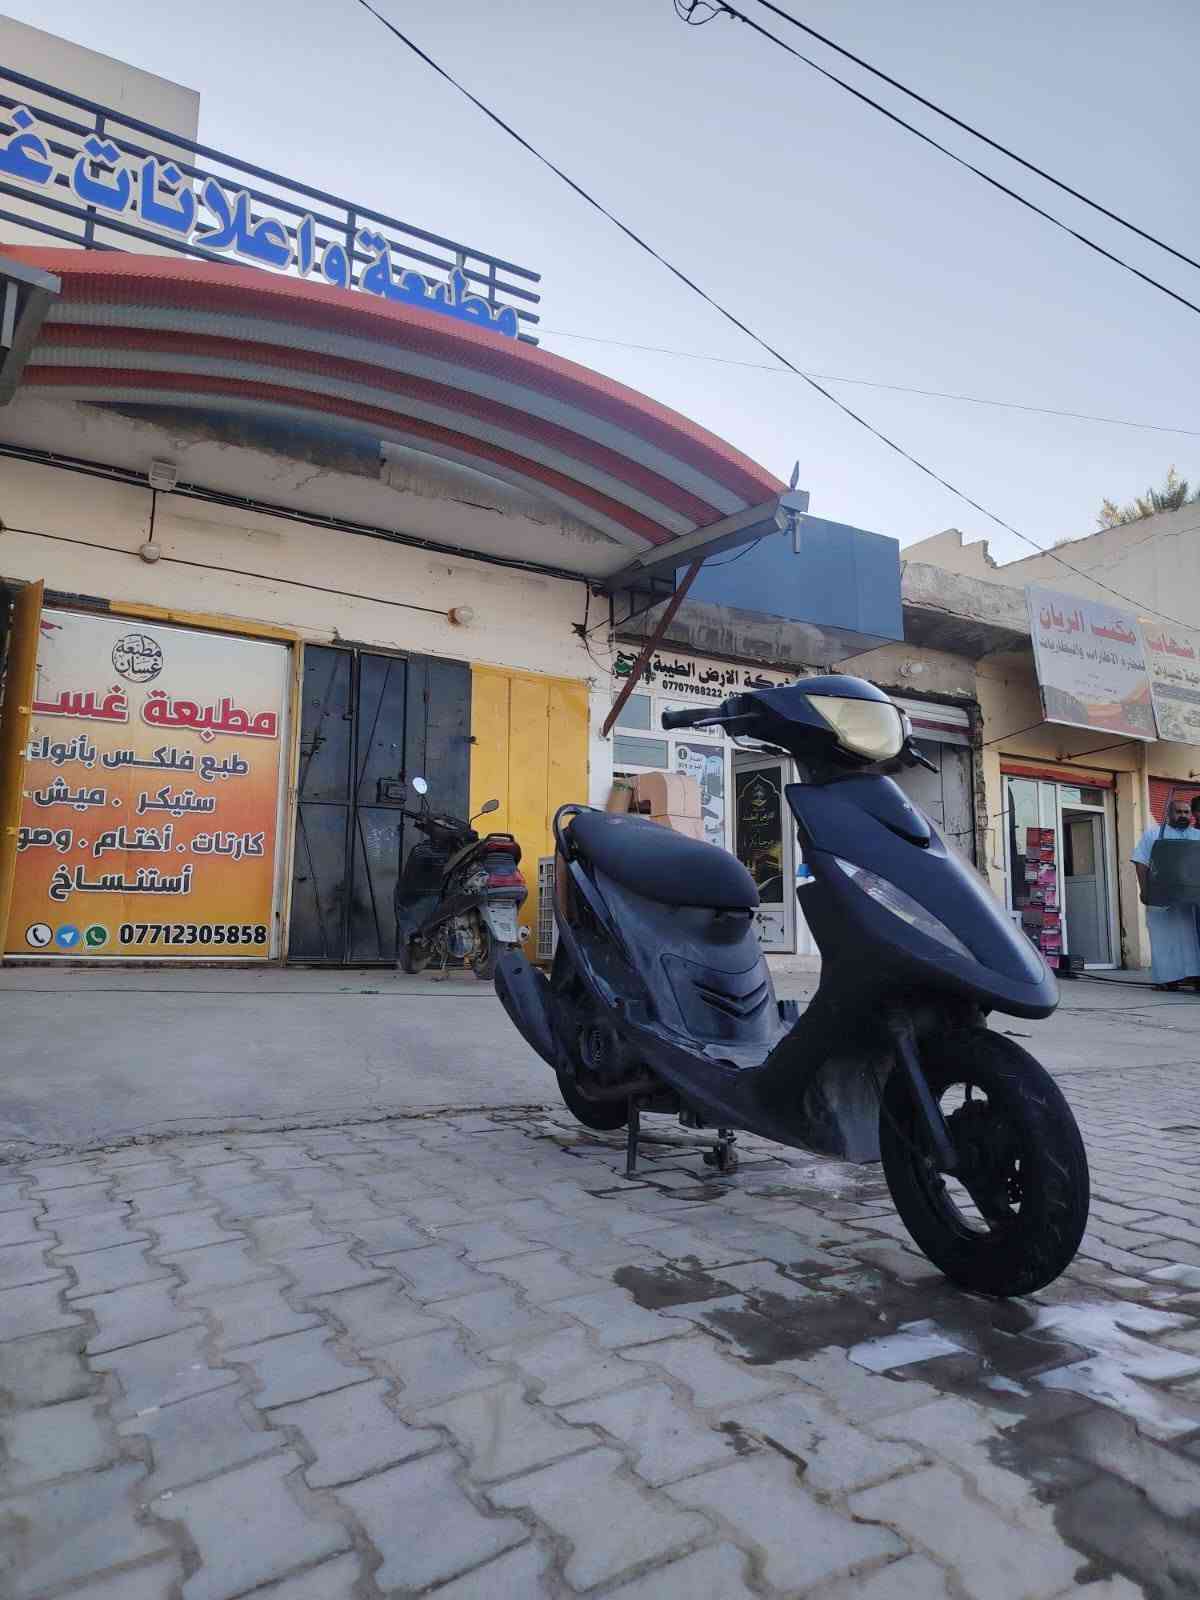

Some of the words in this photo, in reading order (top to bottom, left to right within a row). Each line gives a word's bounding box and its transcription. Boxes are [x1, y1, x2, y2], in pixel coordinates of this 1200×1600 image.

[355, 226, 518, 340] مطبعة
[116, 635, 162, 658] مطبعة
[654, 655, 695, 678] الطيبة
[699, 667, 738, 687] الارض
[32, 685, 128, 722] غس
[143, 690, 278, 742] مطبعة
[101, 744, 196, 771] فلكس
[199, 753, 248, 779] طبع
[33, 777, 105, 810] ميش
[137, 786, 215, 817] ستيكر
[94, 824, 173, 857] أختام
[192, 832, 264, 860] كارتات
[49, 864, 193, 901] أستنساخ
[120, 924, 267, 945] 07712305858
